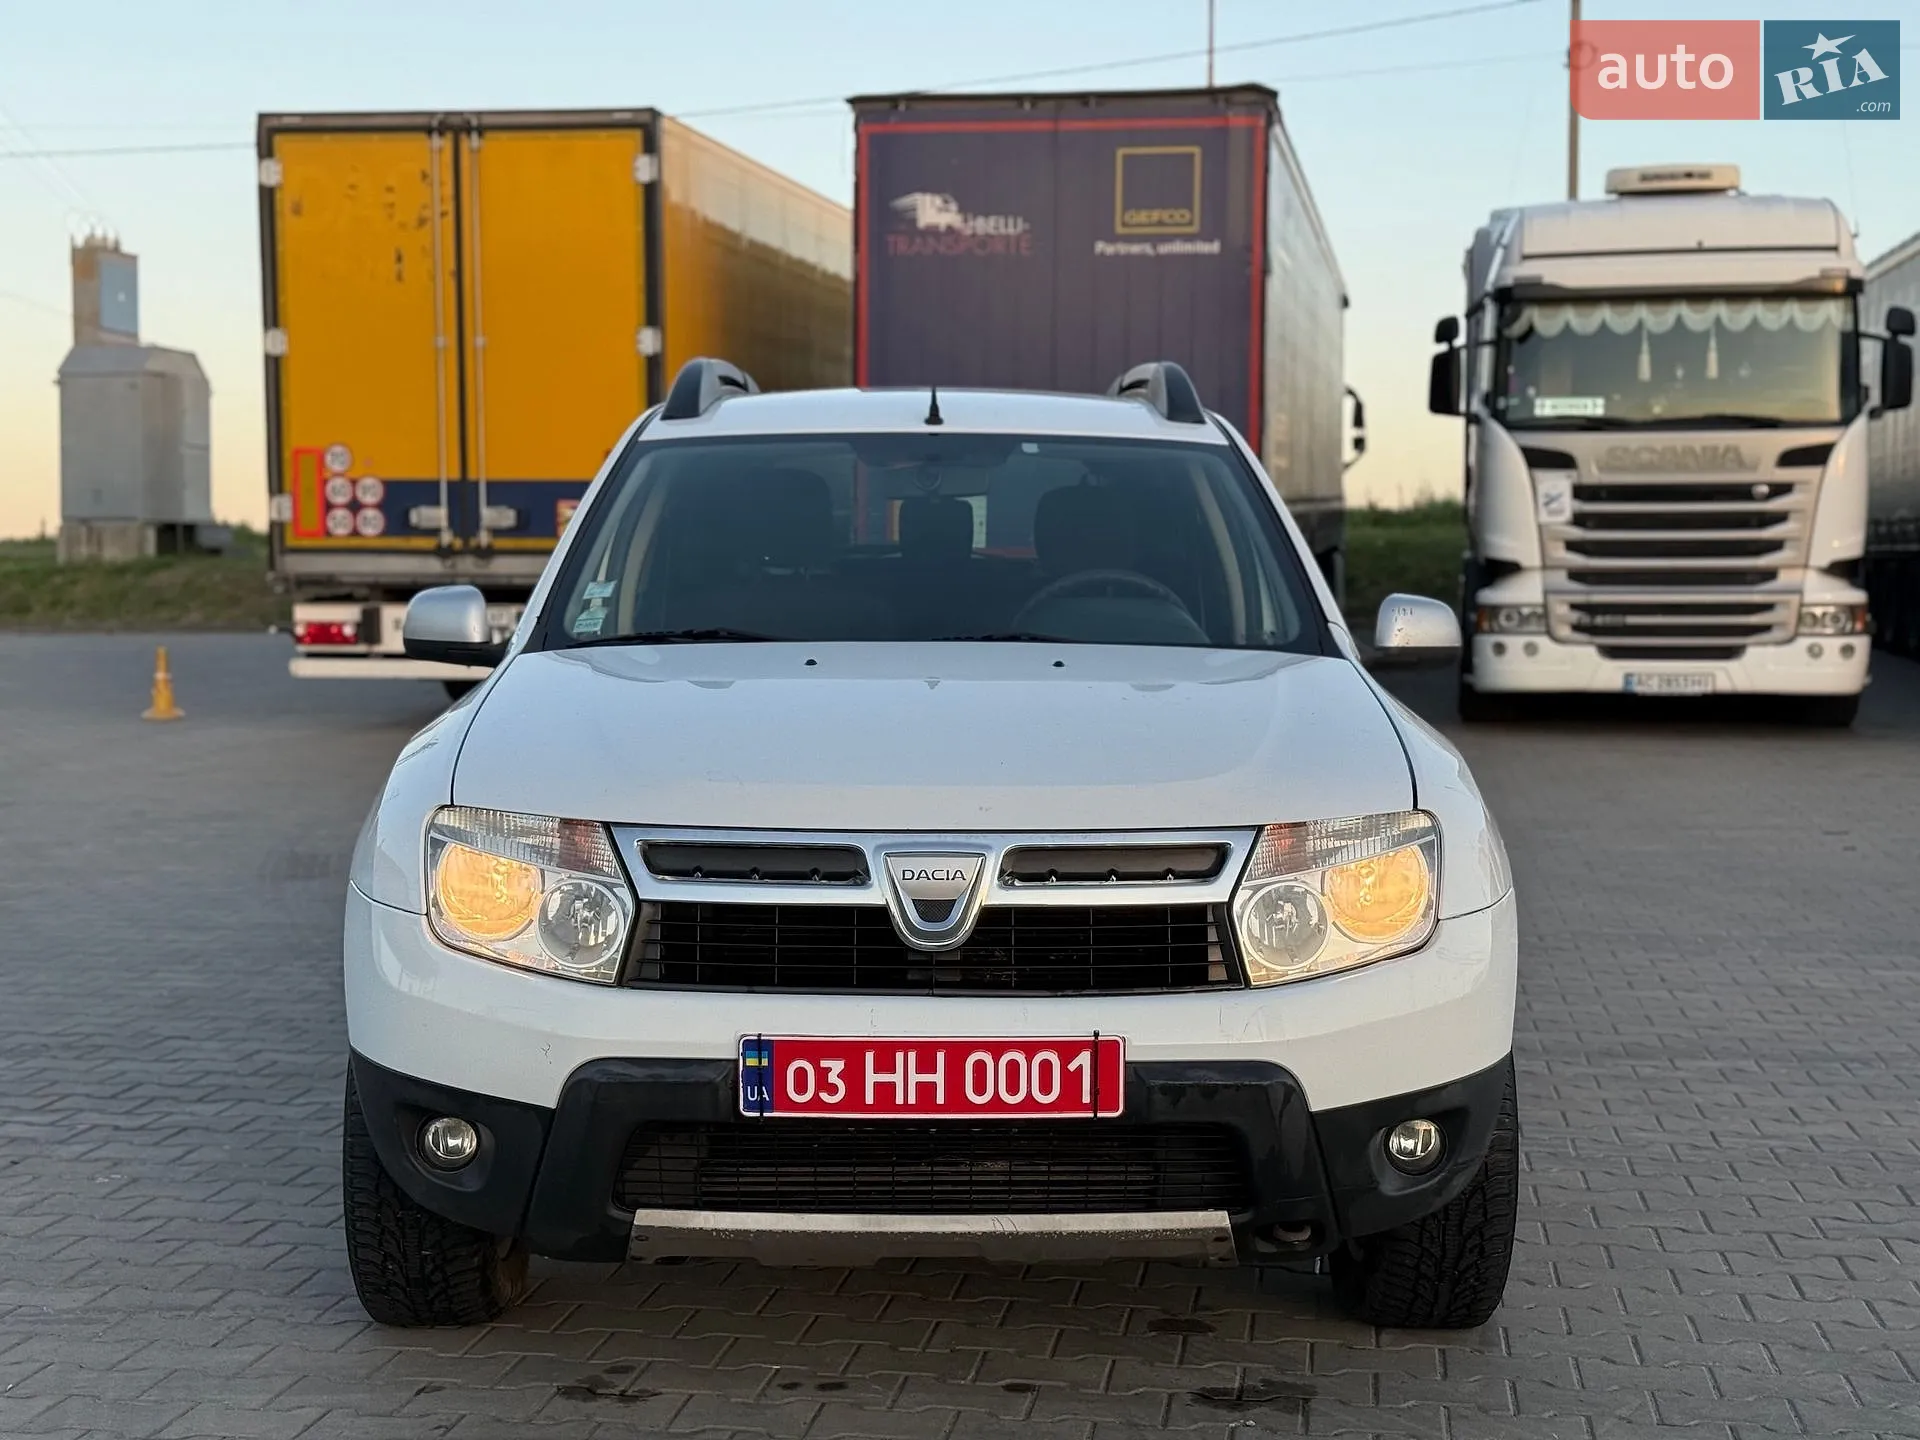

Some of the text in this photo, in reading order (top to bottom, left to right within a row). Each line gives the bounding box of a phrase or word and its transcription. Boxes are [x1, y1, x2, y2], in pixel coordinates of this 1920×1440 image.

[1124, 208, 1192, 225] GEFCO
[887, 233, 1032, 257] TRANSPORTE
[1094, 238, 1221, 257] Partners, unlimited
[1605, 445, 1743, 470] SCANIA
[901, 869, 967, 881] DACIA
[786, 1049, 1092, 1105] 03 HH 0001
